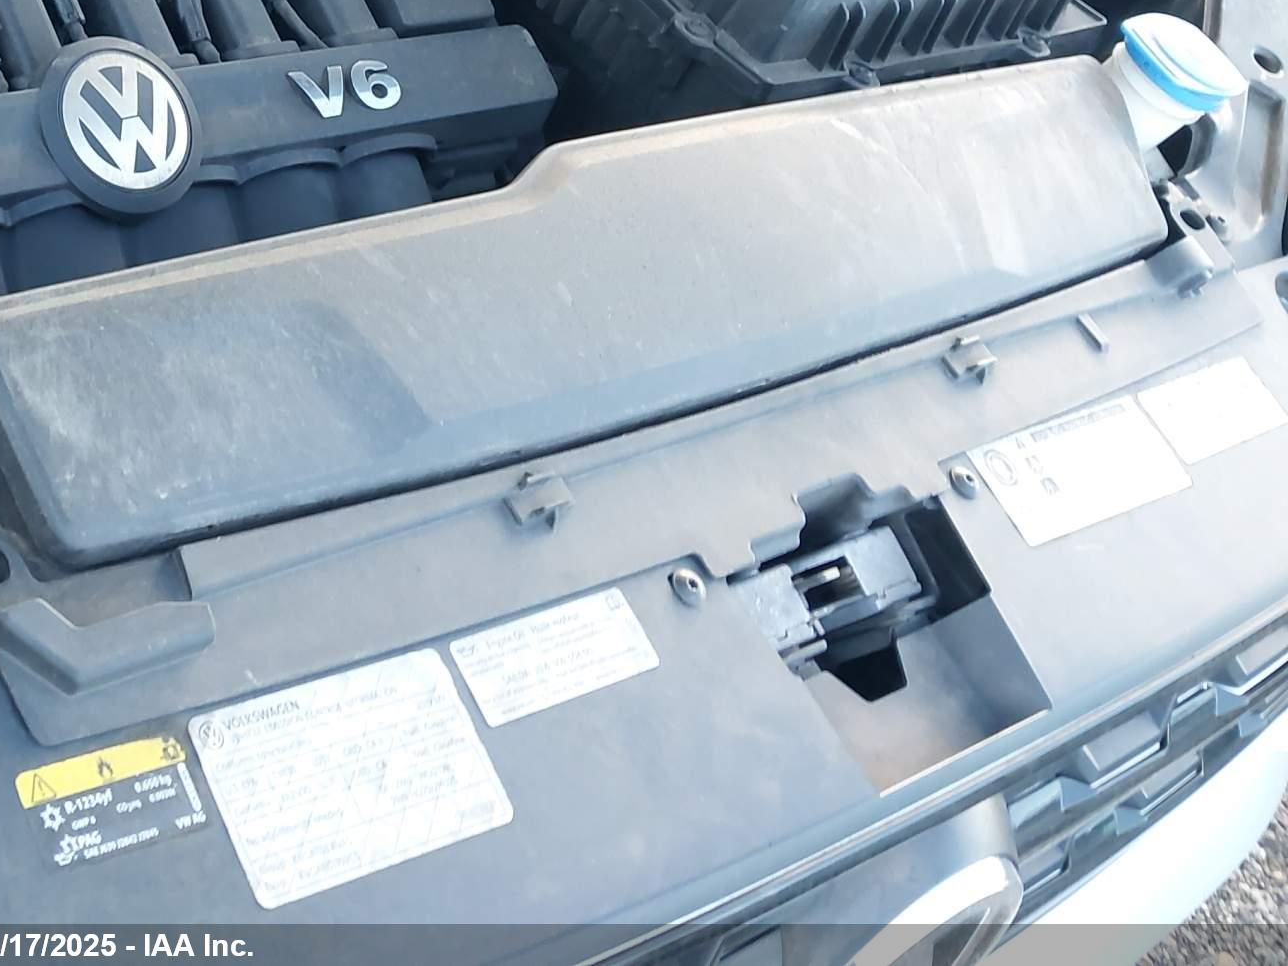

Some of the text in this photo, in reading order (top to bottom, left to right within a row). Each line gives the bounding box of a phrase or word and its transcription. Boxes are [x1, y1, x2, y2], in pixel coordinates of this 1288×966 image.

[287, 59, 403, 120] V6
[222, 699, 301, 731] VOLKSWAGEN
[64, 788, 112, 815] R-1234yf
